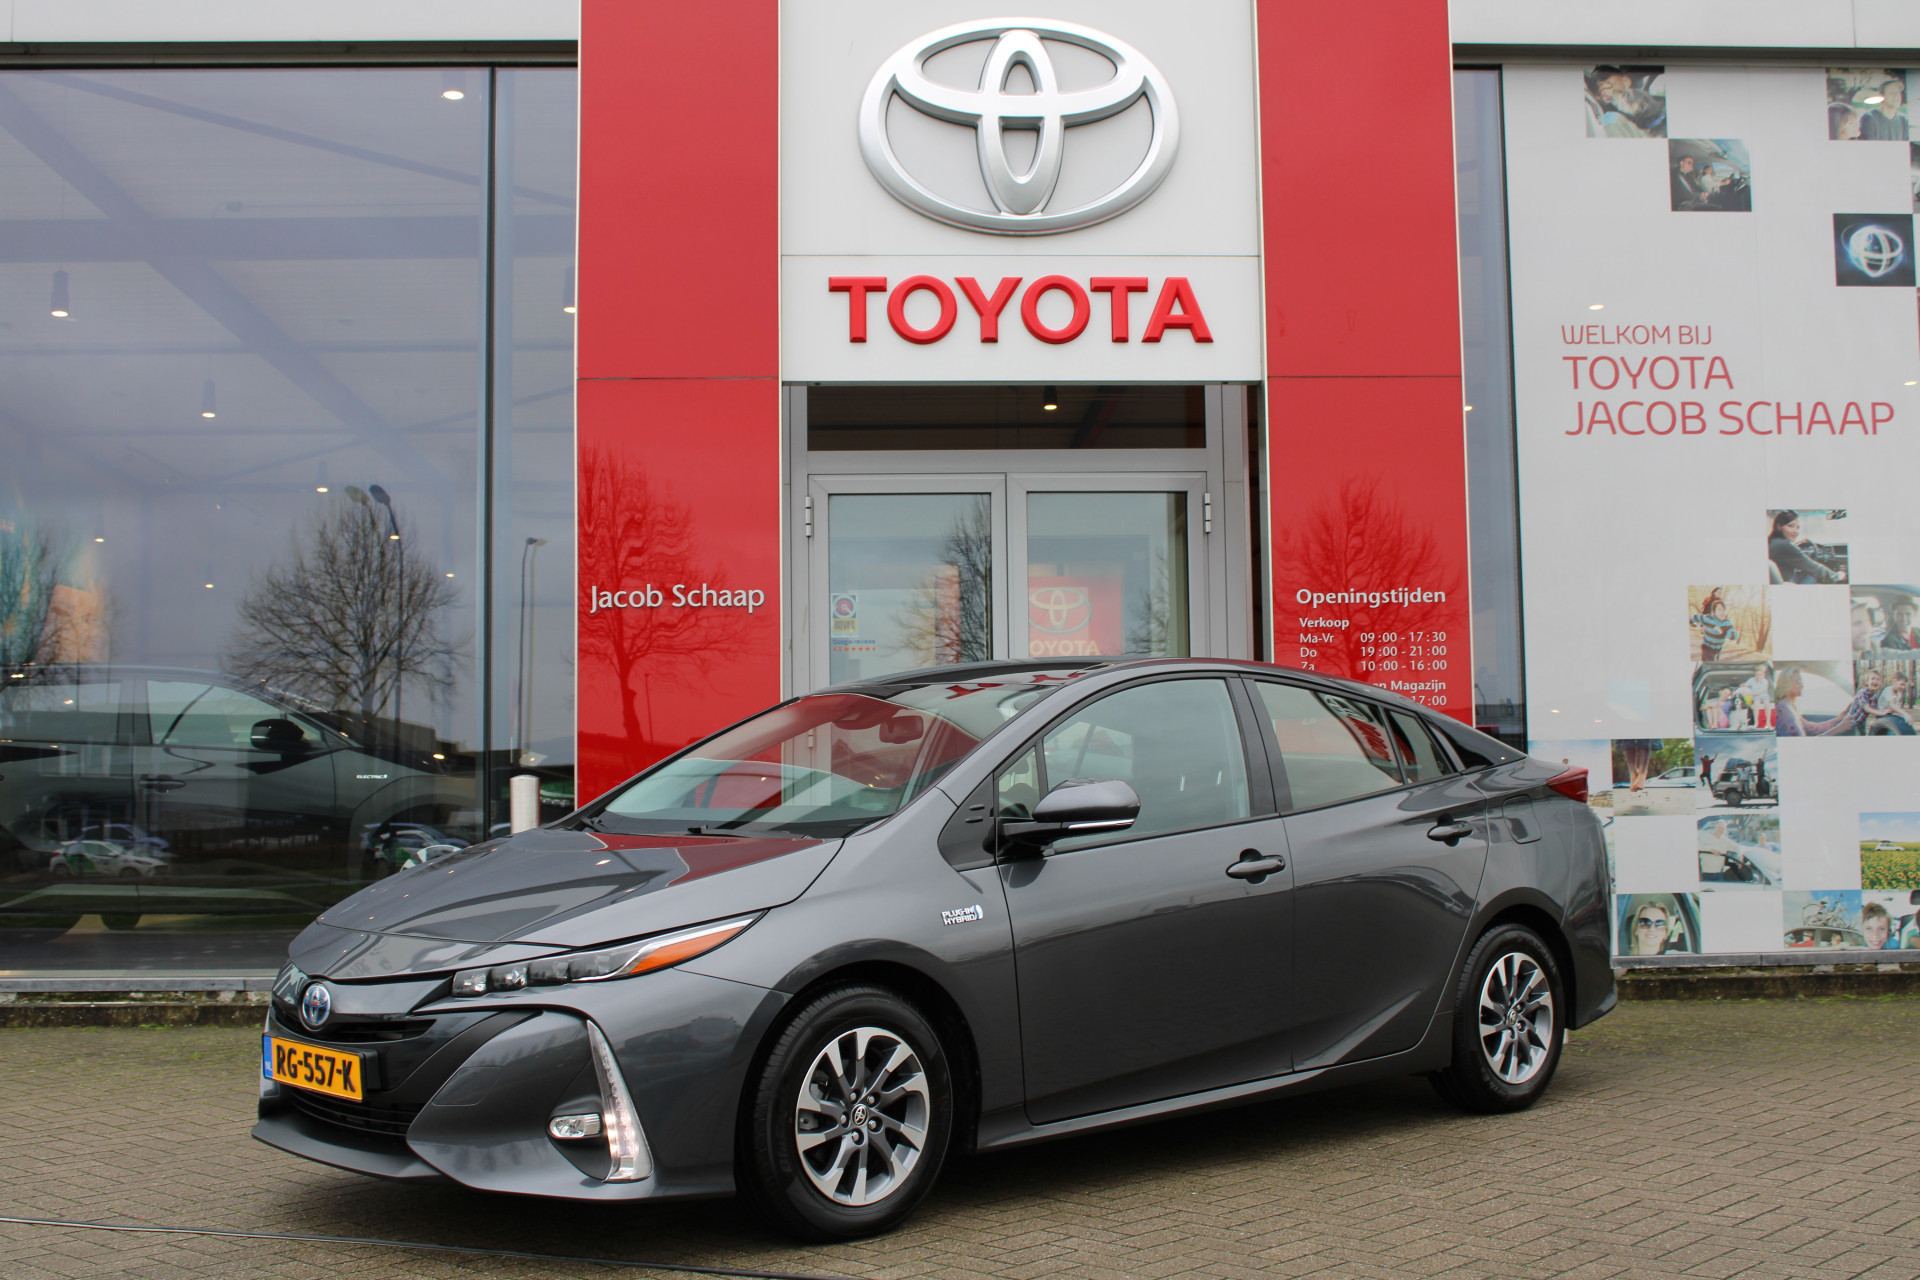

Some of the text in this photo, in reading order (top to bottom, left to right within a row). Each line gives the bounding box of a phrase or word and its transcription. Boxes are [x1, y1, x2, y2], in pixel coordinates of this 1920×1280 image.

[828, 274, 1214, 345] TOYOTA
[1561, 325, 1712, 345] WELKOM BIJ
[1562, 356, 1734, 390] TOYOTA
[1565, 401, 1894, 436] JACOB SCHAAP
[590, 583, 765, 613] Jacob Schaap
[1296, 587, 1446, 608] Openingstijden
[1299, 617, 1350, 630] Verkoop
[1300, 633, 1334, 643] Ma-Vr
[1029, 640, 1101, 656] OYOTA
[1300, 647, 1317, 658] Do
[1391, 680, 1446, 693] Magazijn
[942, 905, 974, 918] PLUG-IN
[943, 914, 976, 925] HYBRID
[276, 1044, 356, 1093] RG-557-K
